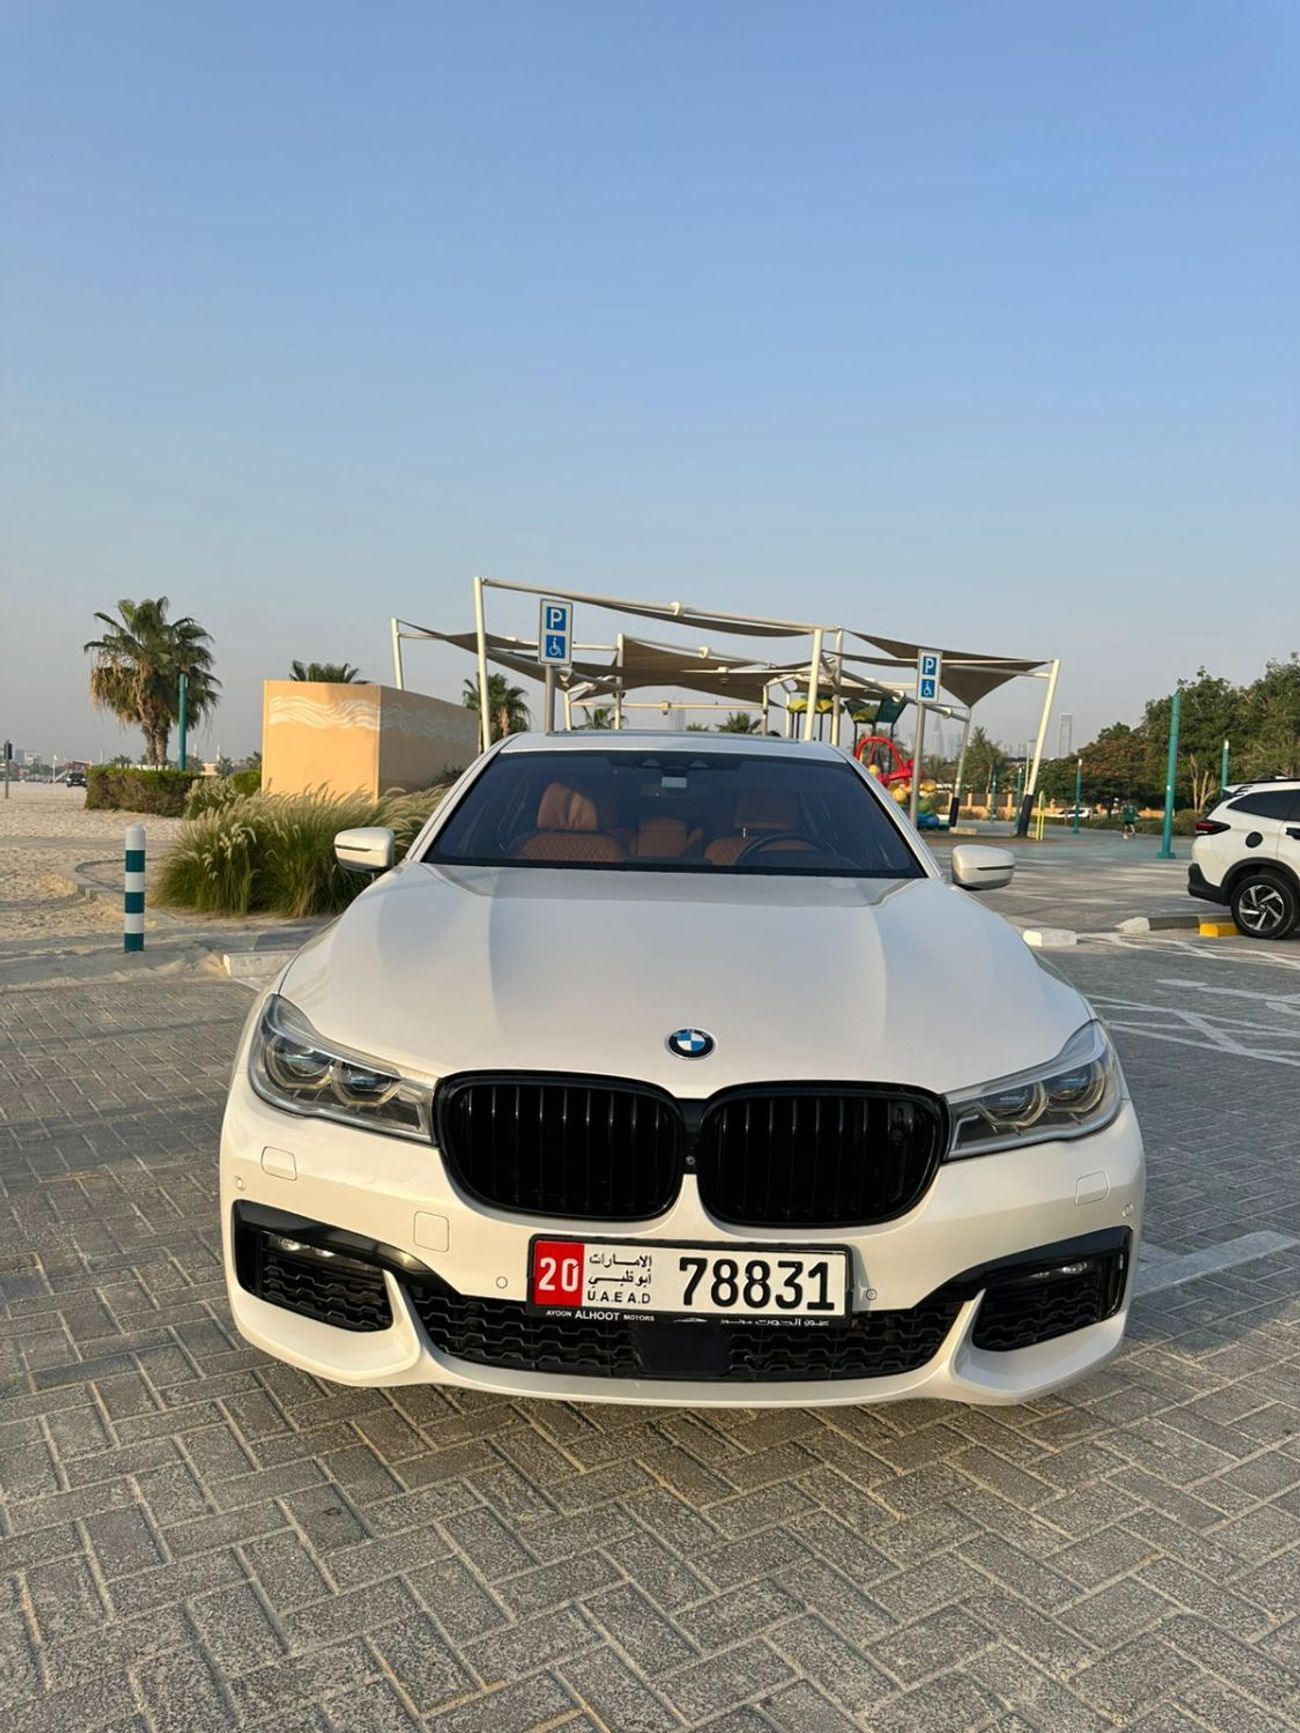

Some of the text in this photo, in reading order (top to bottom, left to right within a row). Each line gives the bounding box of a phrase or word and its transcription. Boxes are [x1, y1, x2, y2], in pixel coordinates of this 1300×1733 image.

[550, 608, 563, 629] P
[925, 657, 935, 674] P
[538, 1256, 579, 1293] 20
[679, 1256, 835, 1311] 78831
[575, 1310, 620, 1321] ALHOOT
[623, 1314, 655, 1322] MOTORS
